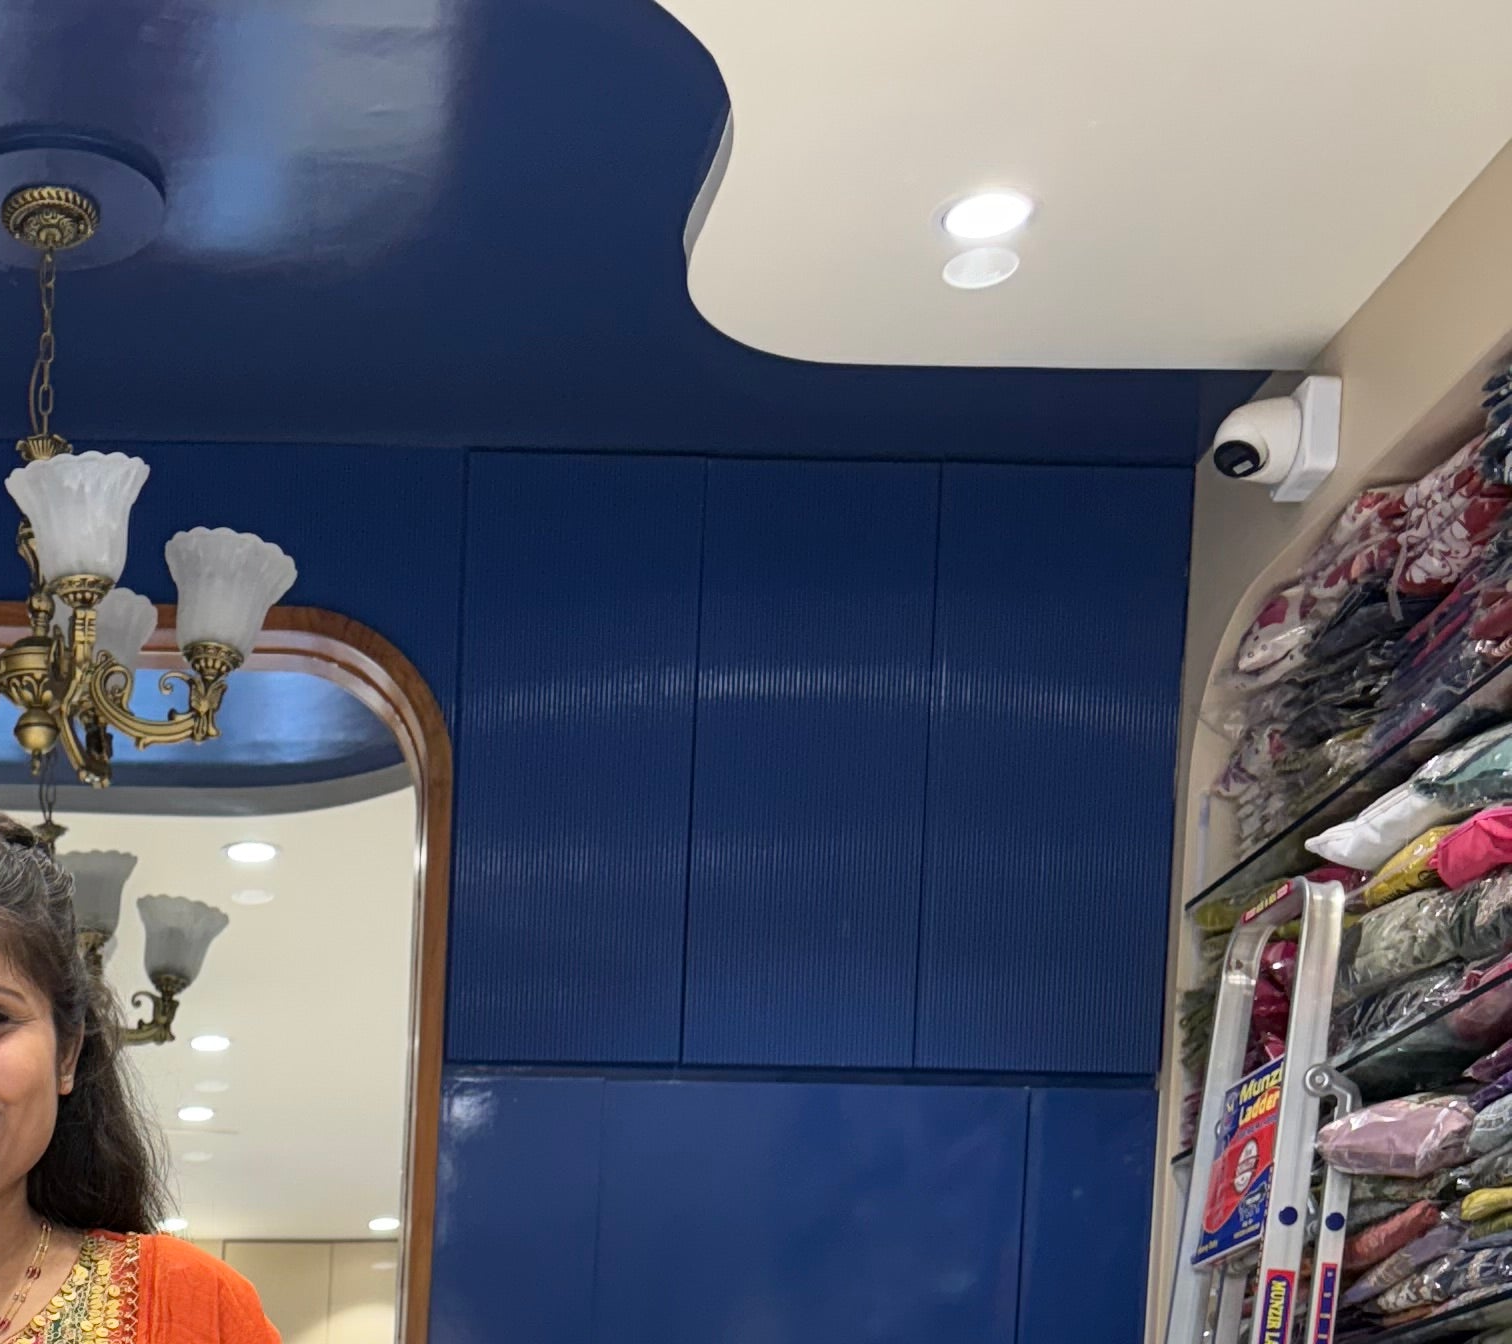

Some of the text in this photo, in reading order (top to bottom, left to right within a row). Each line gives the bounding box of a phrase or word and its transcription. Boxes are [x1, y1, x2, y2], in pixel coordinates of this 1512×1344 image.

[1239, 1061, 1285, 1105] Munzi
[1239, 1090, 1281, 1126] Ladder
[1266, 1280, 1287, 1330] MUNZIR
